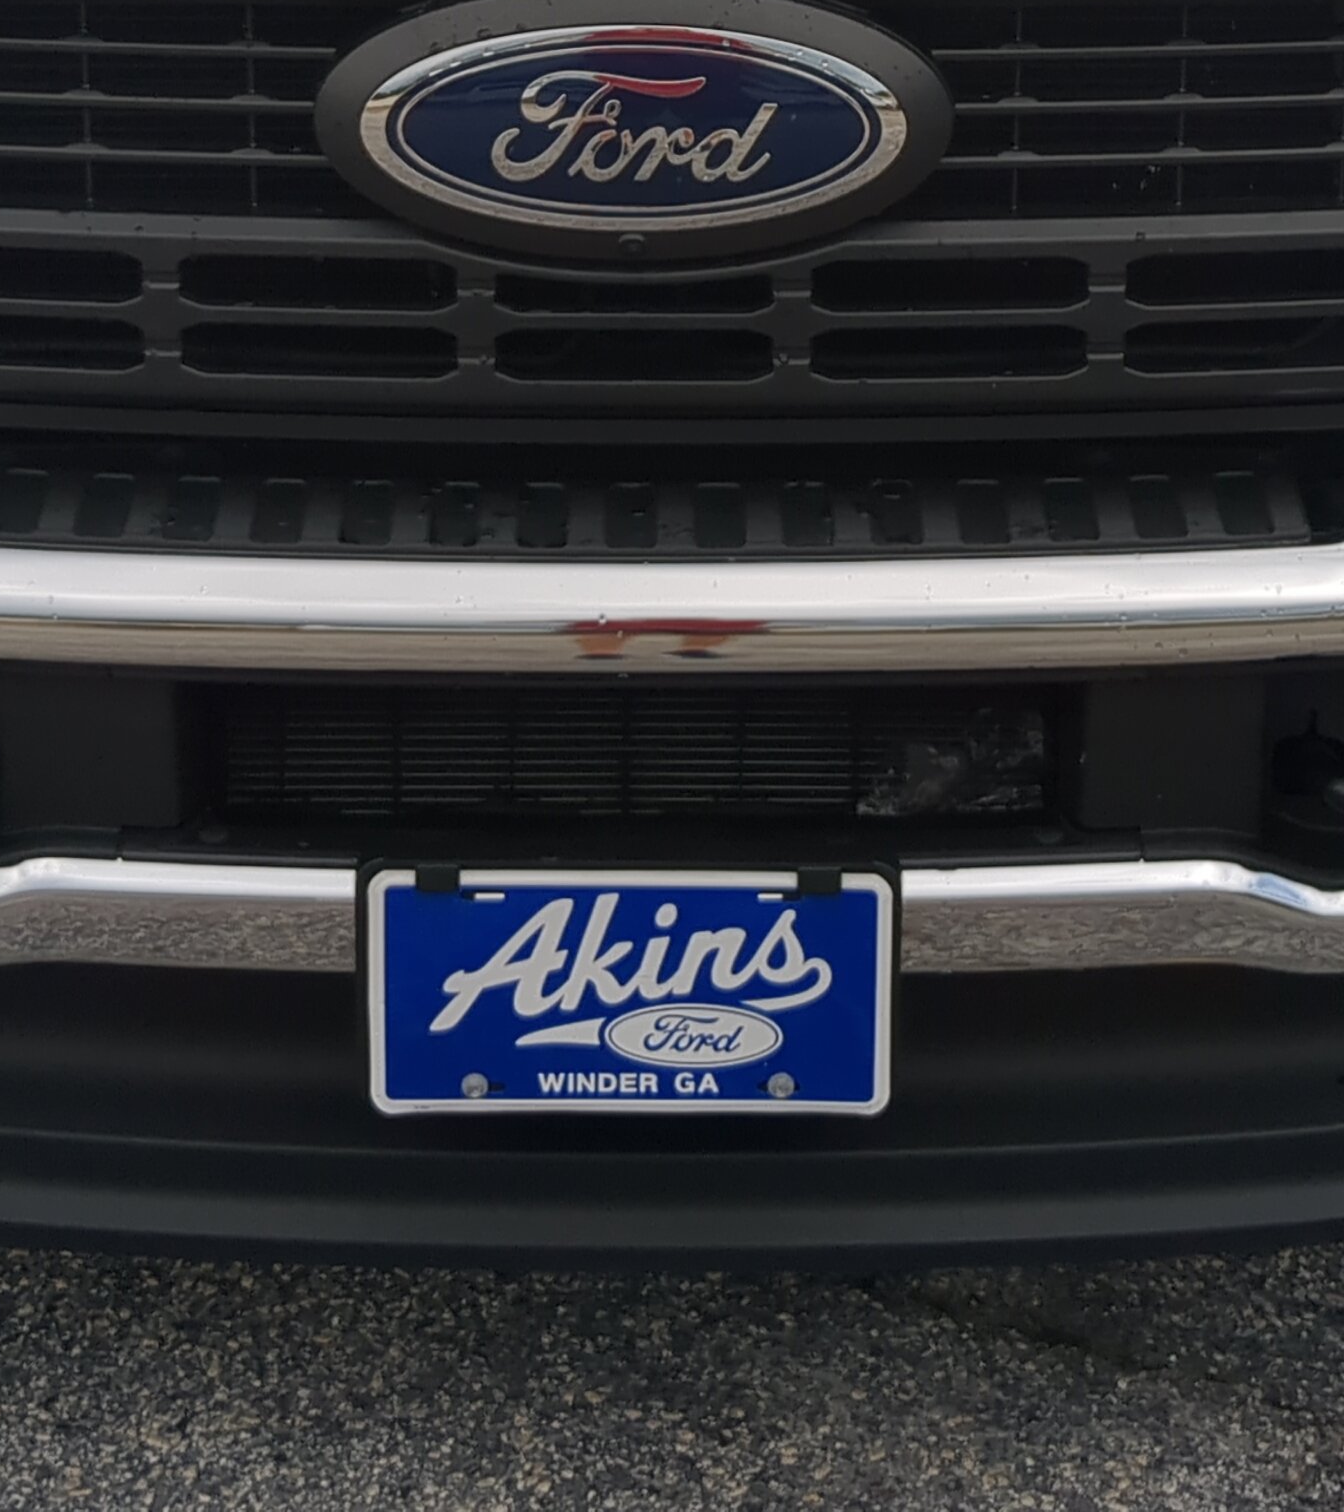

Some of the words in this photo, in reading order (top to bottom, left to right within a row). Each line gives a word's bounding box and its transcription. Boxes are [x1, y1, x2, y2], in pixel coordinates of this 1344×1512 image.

[490, 69, 777, 183] Ford
[429, 892, 832, 1032] Akins
[642, 1014, 742, 1055] Ford
[537, 1071, 660, 1095] WINDER
[673, 1071, 720, 1095] GA
